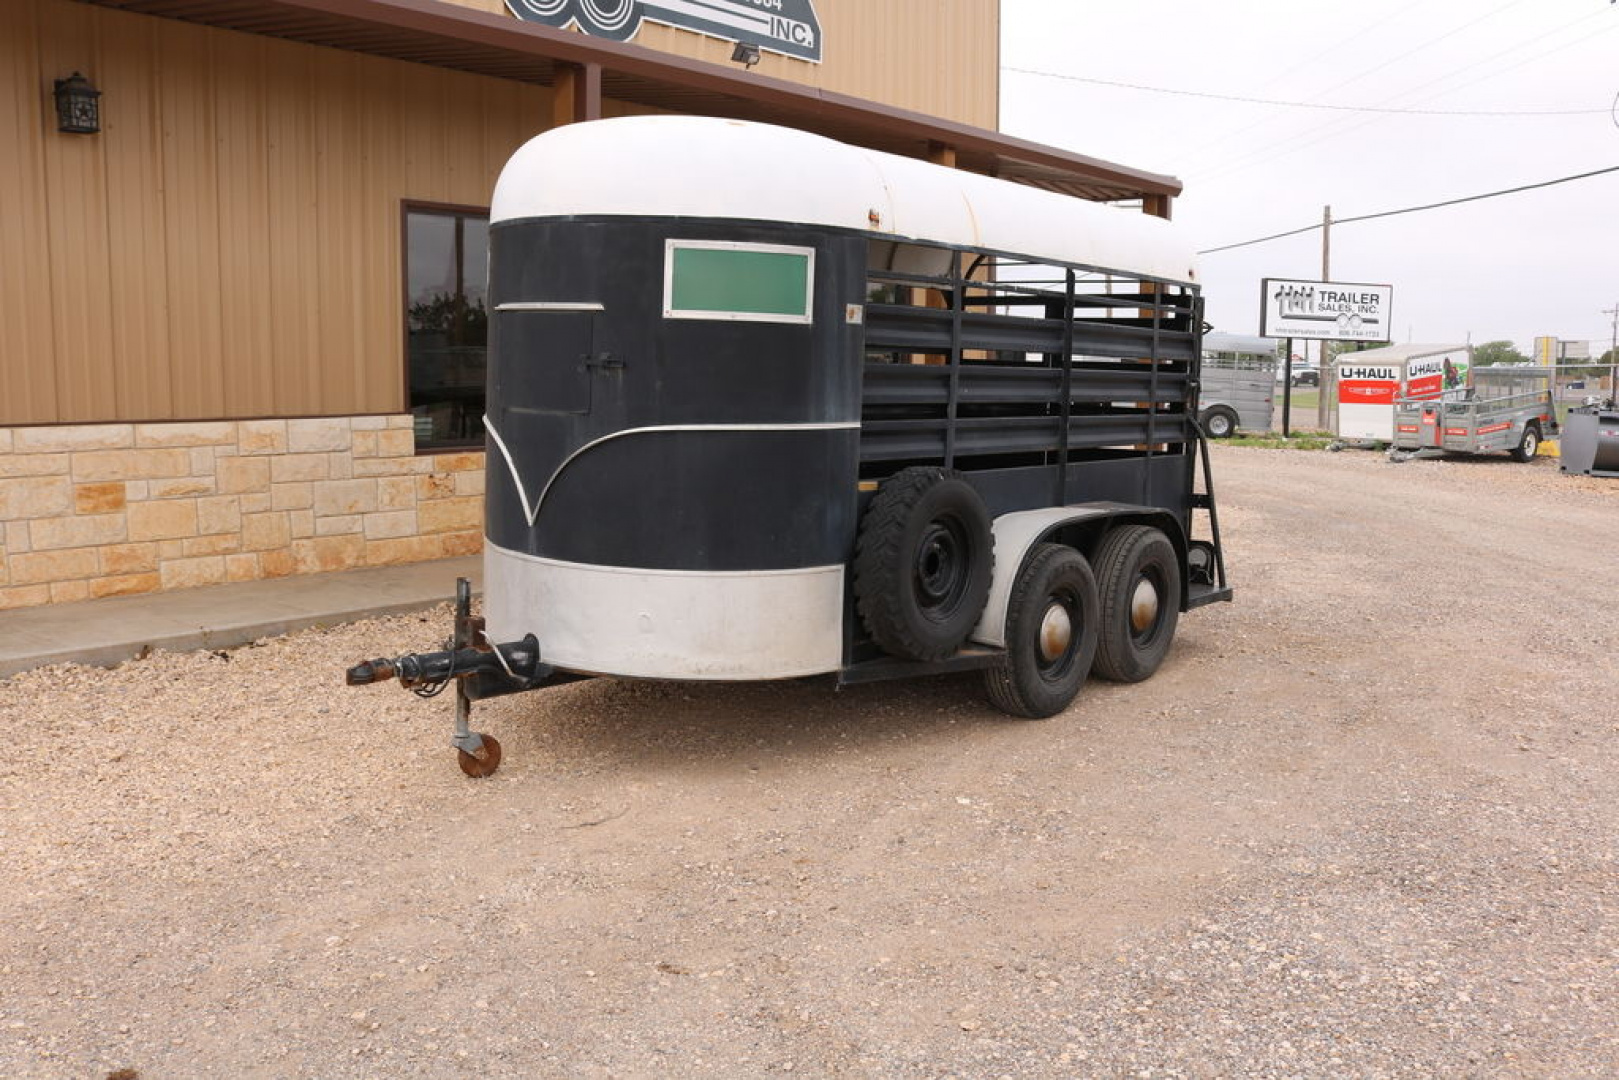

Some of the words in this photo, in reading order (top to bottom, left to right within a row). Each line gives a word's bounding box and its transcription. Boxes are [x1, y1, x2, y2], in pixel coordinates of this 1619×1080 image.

[770, 16, 811, 46] INC.
[1318, 290, 1379, 305] TRAILER
[1358, 304, 1379, 314] INC.
[1341, 367, 1396, 379] U-HAUL
[1409, 361, 1442, 377] U-HAUL
